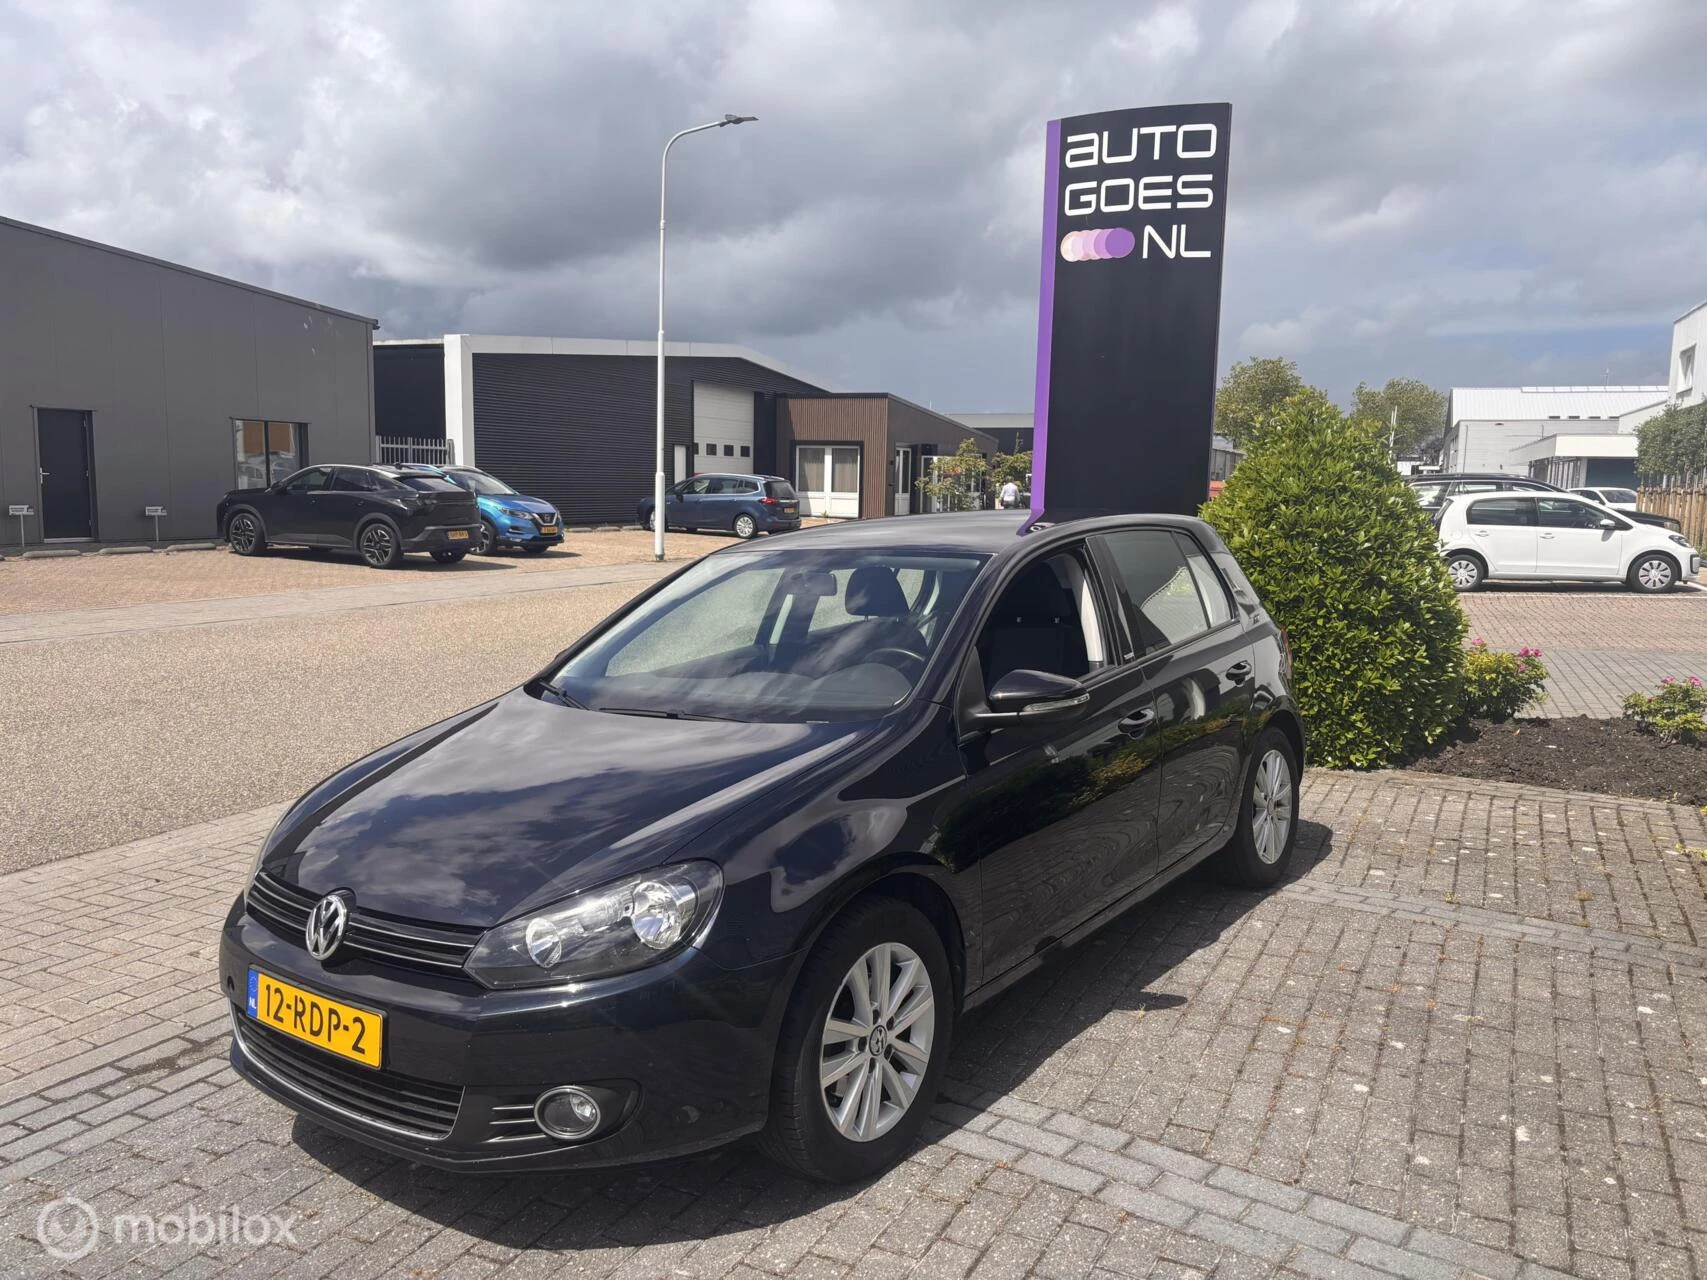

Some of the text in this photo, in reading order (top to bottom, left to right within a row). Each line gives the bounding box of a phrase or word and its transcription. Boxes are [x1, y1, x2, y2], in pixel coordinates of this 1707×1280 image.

[1064, 173, 1214, 217] GOES
[1142, 223, 1212, 259] NL
[265, 983, 366, 1056] 12-RDP-2
